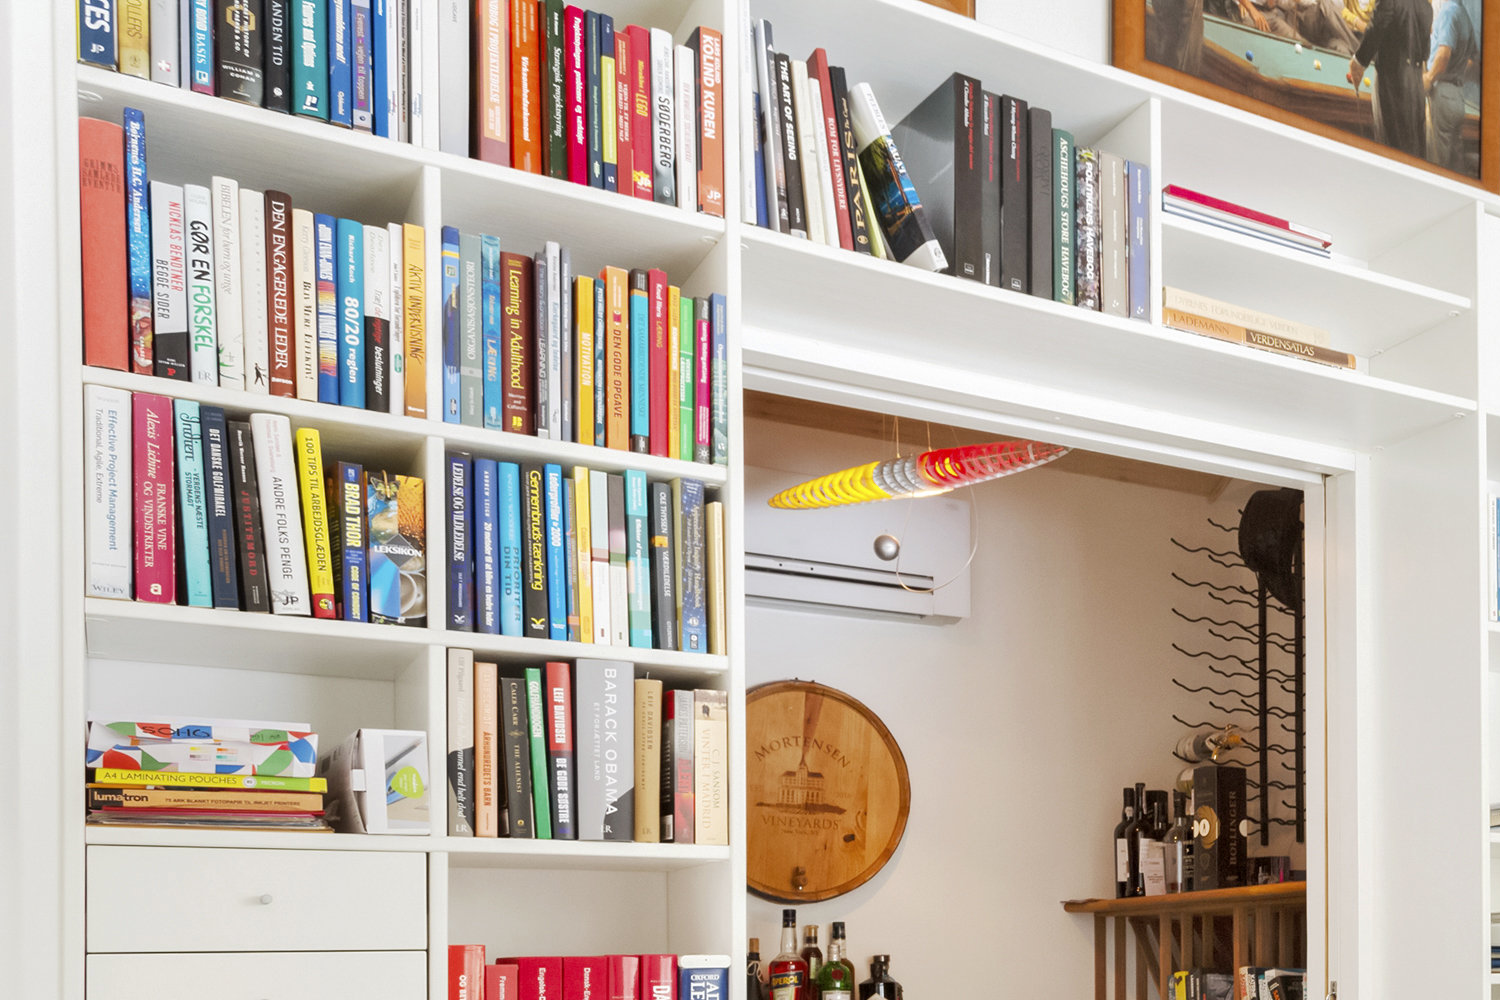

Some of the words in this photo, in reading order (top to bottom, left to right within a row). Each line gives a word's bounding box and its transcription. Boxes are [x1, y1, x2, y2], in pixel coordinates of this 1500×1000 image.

[196, 33, 208, 65] BASIS
[273, 46, 284, 66] TID
[554, 47, 563, 82] Strategisk
[703, 35, 715, 87] KOLIND
[488, 32, 500, 104] PROJEKTLEDELSE
[780, 61, 789, 81] THE
[521, 56, 530, 141] Virksomhedsøkonomi
[553, 83, 563, 137] projektstyring
[636, 93, 648, 117] LEGO
[781, 82, 791, 103] ART
[704, 90, 716, 139] KUREN
[783, 106, 793, 121] OF
[828, 118, 837, 137] ROM
[130, 121, 144, 165] Børnenes
[658, 97, 671, 168] SØDERBERG
[785, 123, 796, 160] SEEING
[830, 140, 839, 156] FOR
[833, 159, 848, 210] LIVSNYDERE
[844, 131, 865, 230] PARIS
[1061, 138, 1070, 208] ASCHEHOUGS
[220, 184, 231, 224] BIBELEN
[1085, 162, 1095, 225] POLITIKENS
[132, 189, 145, 234] Andersen
[169, 201, 182, 240] NICKLAS
[272, 201, 285, 229] DEN
[1061, 211, 1070, 243] STORE
[190, 221, 209, 255] GØR
[347, 235, 356, 263] Richard
[1086, 227, 1096, 279] HAVEBOG
[156, 259, 169, 288] BEGGE
[170, 244, 183, 291] BENDTNER
[191, 260, 211, 281] EN
[273, 234, 287, 324] ENGAGEREDE
[348, 265, 356, 283] Koch
[409, 264, 423, 290] AKTIV
[1062, 246, 1071, 295] HAVEBOG
[157, 292, 170, 318] SIDER
[505, 270, 522, 315] Learning
[192, 285, 212, 352] FORSKEL
[345, 296, 360, 345] 80/20
[408, 296, 423, 364] UNDERVISNING
[1173, 313, 1230, 336] LADEMANN
[274, 327, 288, 370] LEDER
[613, 330, 622, 349] DEN
[1250, 332, 1315, 357] VERDENSATLAS
[347, 348, 358, 383] reglen
[374, 346, 385, 395] beslutninger
[487, 339, 497, 382] LÆRING
[511, 331, 524, 389] Adulthood
[538, 338, 546, 378] LEARNING
[582, 332, 591, 386] MOTIVATION
[613, 351, 622, 376] GODE
[614, 380, 622, 418] OPGAVE
[108, 410, 118, 452] Effective
[147, 409, 160, 438] Alexis
[209, 428, 220, 442] DET
[147, 441, 161, 479] Lichine
[211, 443, 223, 469] DANSKE
[306, 437, 315, 454] 100
[106, 454, 118, 486] Project
[308, 457, 317, 475] TIPS
[452, 463, 464, 496] LEDELSE
[96, 473, 104, 503] Extreme
[143, 481, 153, 496] OG
[185, 472, 194, 507] STORMAGT
[193, 473, 201, 504] VERDENS
[212, 471, 226, 517] GOLFMIRAKEL
[272, 477, 284, 510] ANDRE
[310, 479, 319, 490] TIL
[345, 483, 361, 515] BRAD
[107, 490, 118, 550] Management
[157, 483, 167, 525] FRANSKE
[195, 505, 204, 529] NÆSTE
[453, 497, 464, 509] OG
[660, 505, 668, 533] THYSSEN
[143, 500, 155, 567] VINDISTRIKTER
[157, 528, 167, 550] VINE
[241, 490, 257, 577] JUSTITSMORD
[276, 513, 288, 544] FOLKS
[311, 493, 326, 571] ARBEJDSGLÆDEN
[346, 516, 362, 548] THOR
[453, 510, 465, 561] VILDLEDELSE
[280, 547, 293, 579] PENGE
[374, 545, 423, 557] LEKSIKON
[504, 547, 512, 569] DIN
[504, 575, 512, 596] TID
[513, 547, 521, 622] PRIORITER
[662, 551, 671, 597] VÆRDILEDELSE
[554, 688, 565, 703] LEIF
[604, 668, 617, 741] BARACK
[554, 705, 566, 743] DAVIDSEN
[701, 729, 711, 769] VINTER
[754, 736, 851, 769] MORTENSEN
[121, 773, 186, 783] LAMINATING
[189, 775, 237, 785] POUCHES
[605, 749, 618, 815] OBAMA
[712, 770, 720, 809] SANSOM
[484, 788, 492, 806] BARN
[702, 782, 711, 829] MADRID
[761, 815, 840, 830] VINEYARDS
[1229, 791, 1237, 865] BOLLINGER
[459, 975, 467, 987] OG
